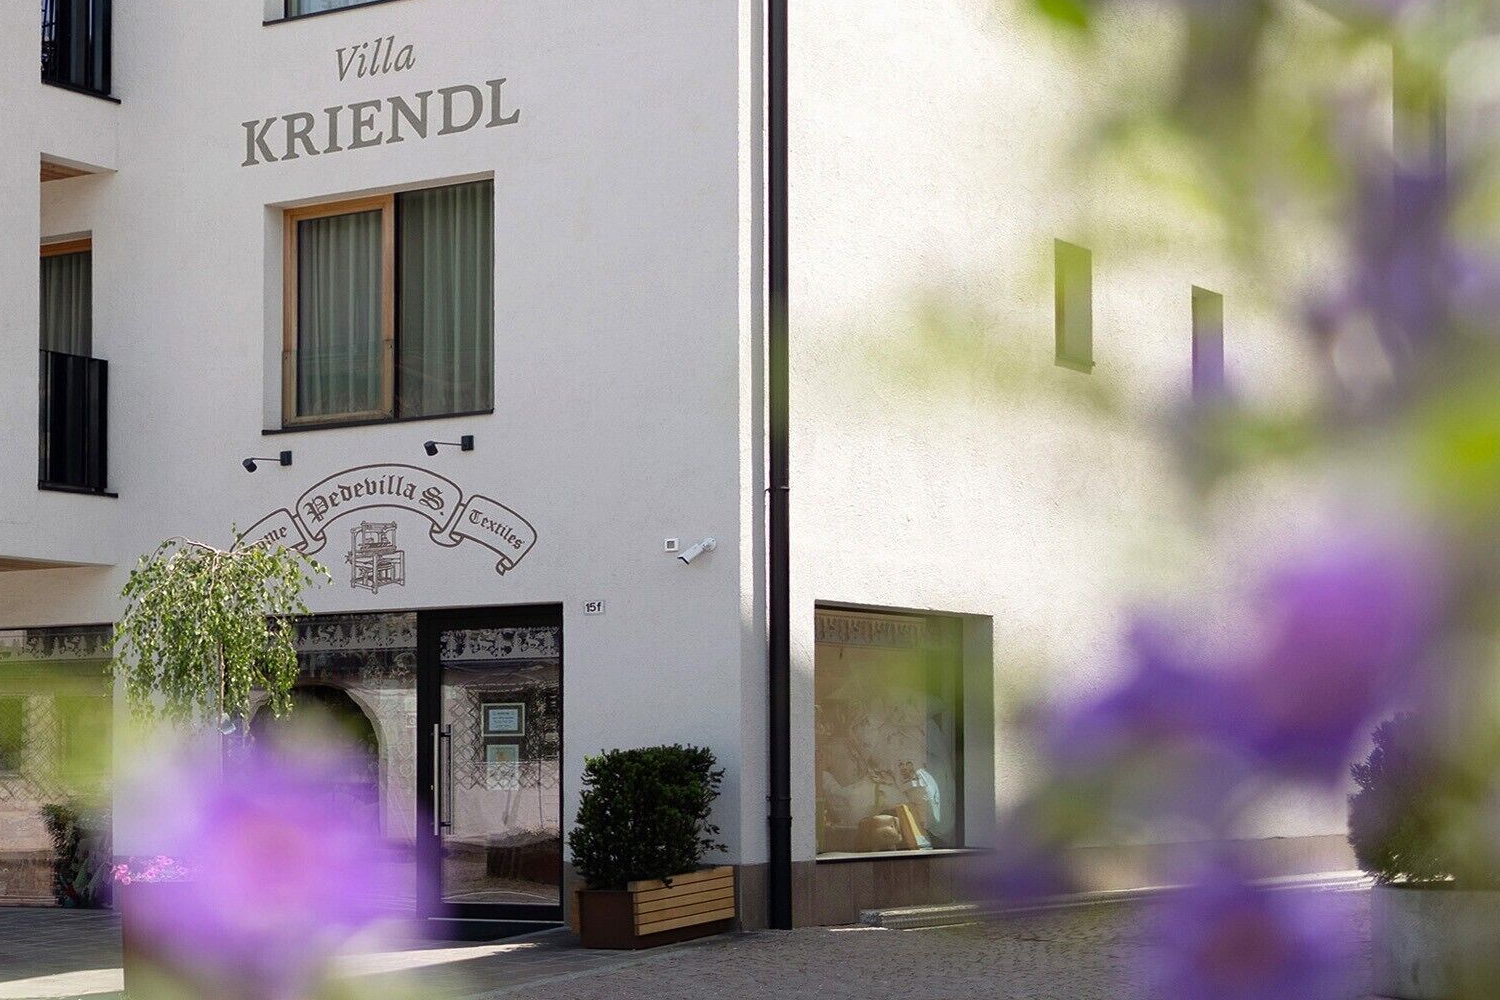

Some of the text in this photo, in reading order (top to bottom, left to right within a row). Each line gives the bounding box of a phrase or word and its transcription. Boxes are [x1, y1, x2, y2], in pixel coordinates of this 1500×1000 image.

[336, 35, 416, 81] Villa
[241, 78, 520, 167] KRIENDL
[304, 475, 416, 524] Pedevilla
[467, 508, 525, 550] Textiles
[585, 601, 601, 612] 15f
